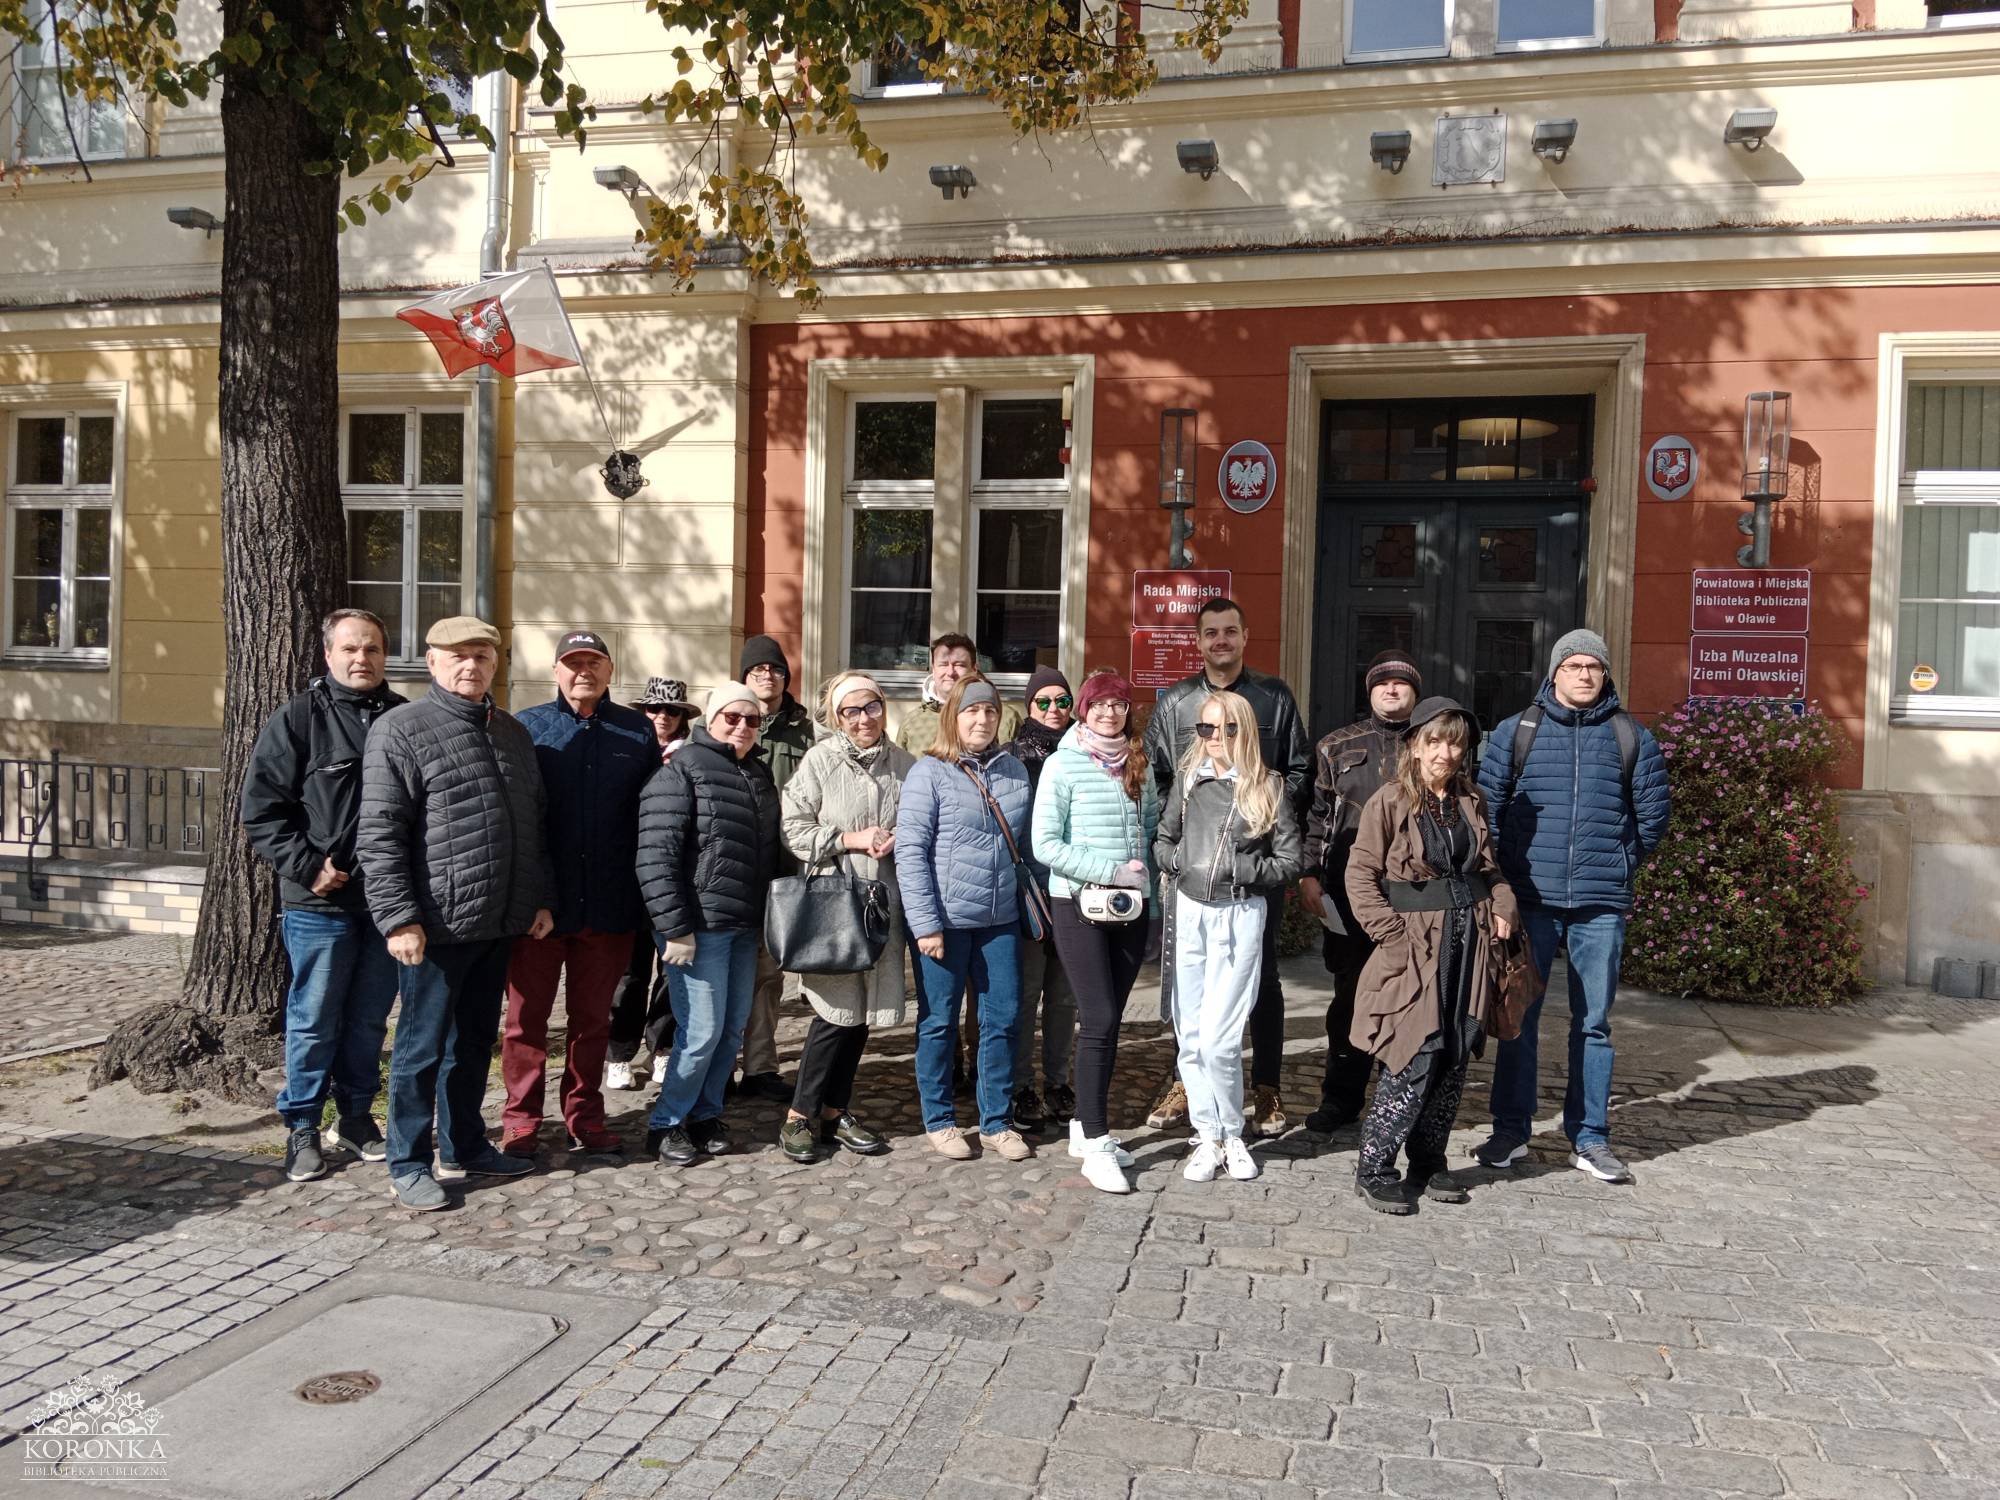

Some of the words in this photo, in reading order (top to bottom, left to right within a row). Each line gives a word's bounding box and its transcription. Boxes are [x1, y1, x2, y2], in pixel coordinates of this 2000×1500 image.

[1695, 577, 1755, 589] Powiatowa
[1758, 577, 1762, 588] i
[1765, 577, 1809, 590] Miejska
[1143, 584, 1173, 597] Rada
[1176, 584, 1222, 599] Miejska
[1155, 603, 1166, 613] w
[1168, 600, 1204, 614] Oławi
[1695, 595, 1751, 606] Biblioteka
[1754, 595, 1808, 606] Publiczna
[1724, 615, 1735, 624] w
[1737, 613, 1777, 624] Oławie
[1700, 649, 1727, 662] Izba
[1732, 650, 1799, 664] Muzealna
[1693, 667, 1732, 681] Ziemi
[1736, 668, 1805, 686] Oławskiej
